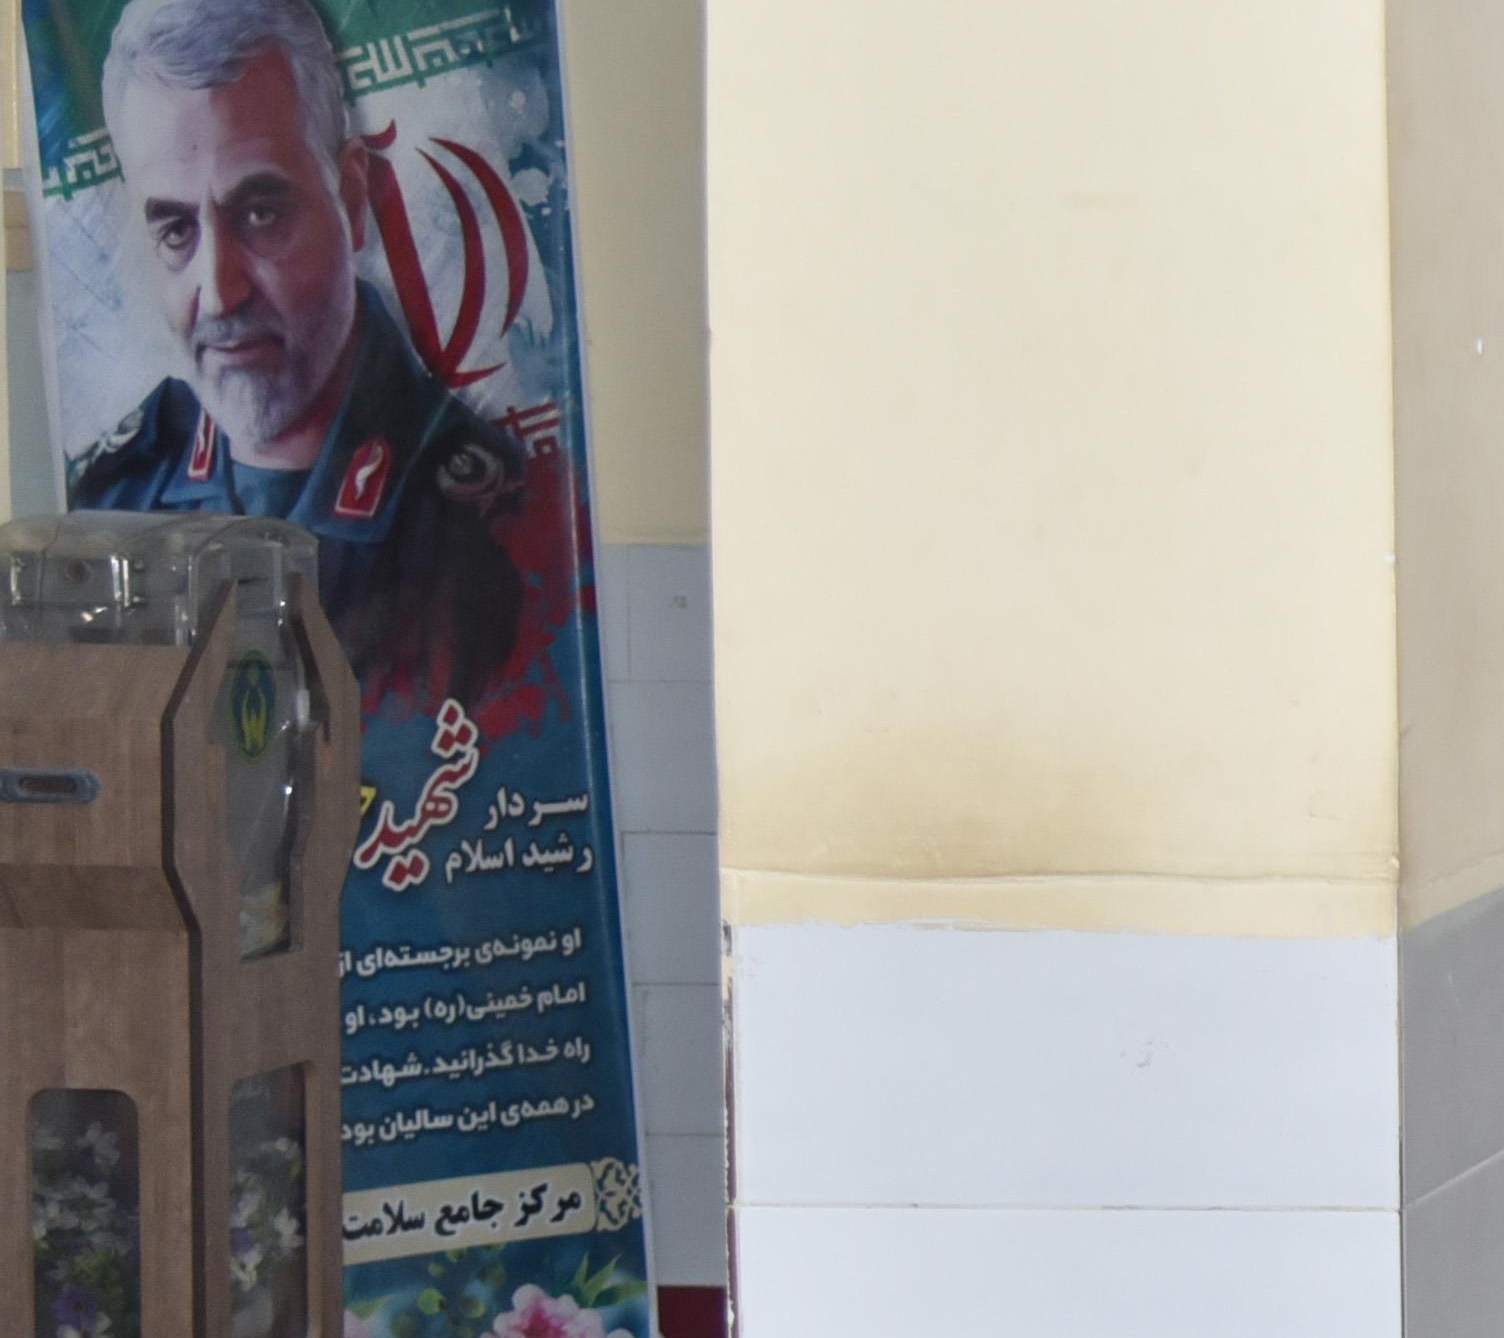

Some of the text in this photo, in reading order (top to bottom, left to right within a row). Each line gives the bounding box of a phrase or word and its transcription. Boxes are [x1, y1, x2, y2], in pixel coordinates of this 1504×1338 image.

[353, 698, 479, 892] شهید
[483, 787, 589, 830] سردار
[445, 832, 593, 883] رشید اسلام
[561, 927, 581, 956] او
[537, 981, 586, 1012] امام
[345, 1004, 365, 1035] او
[517, 1038, 559, 1064] خدا
[564, 1036, 591, 1062] راه
[457, 1102, 497, 1132] این
[570, 1093, 595, 1119] در
[378, 1109, 453, 1141] سالیان
[342, 1183, 582, 1242] مرکز جامع سلامت
